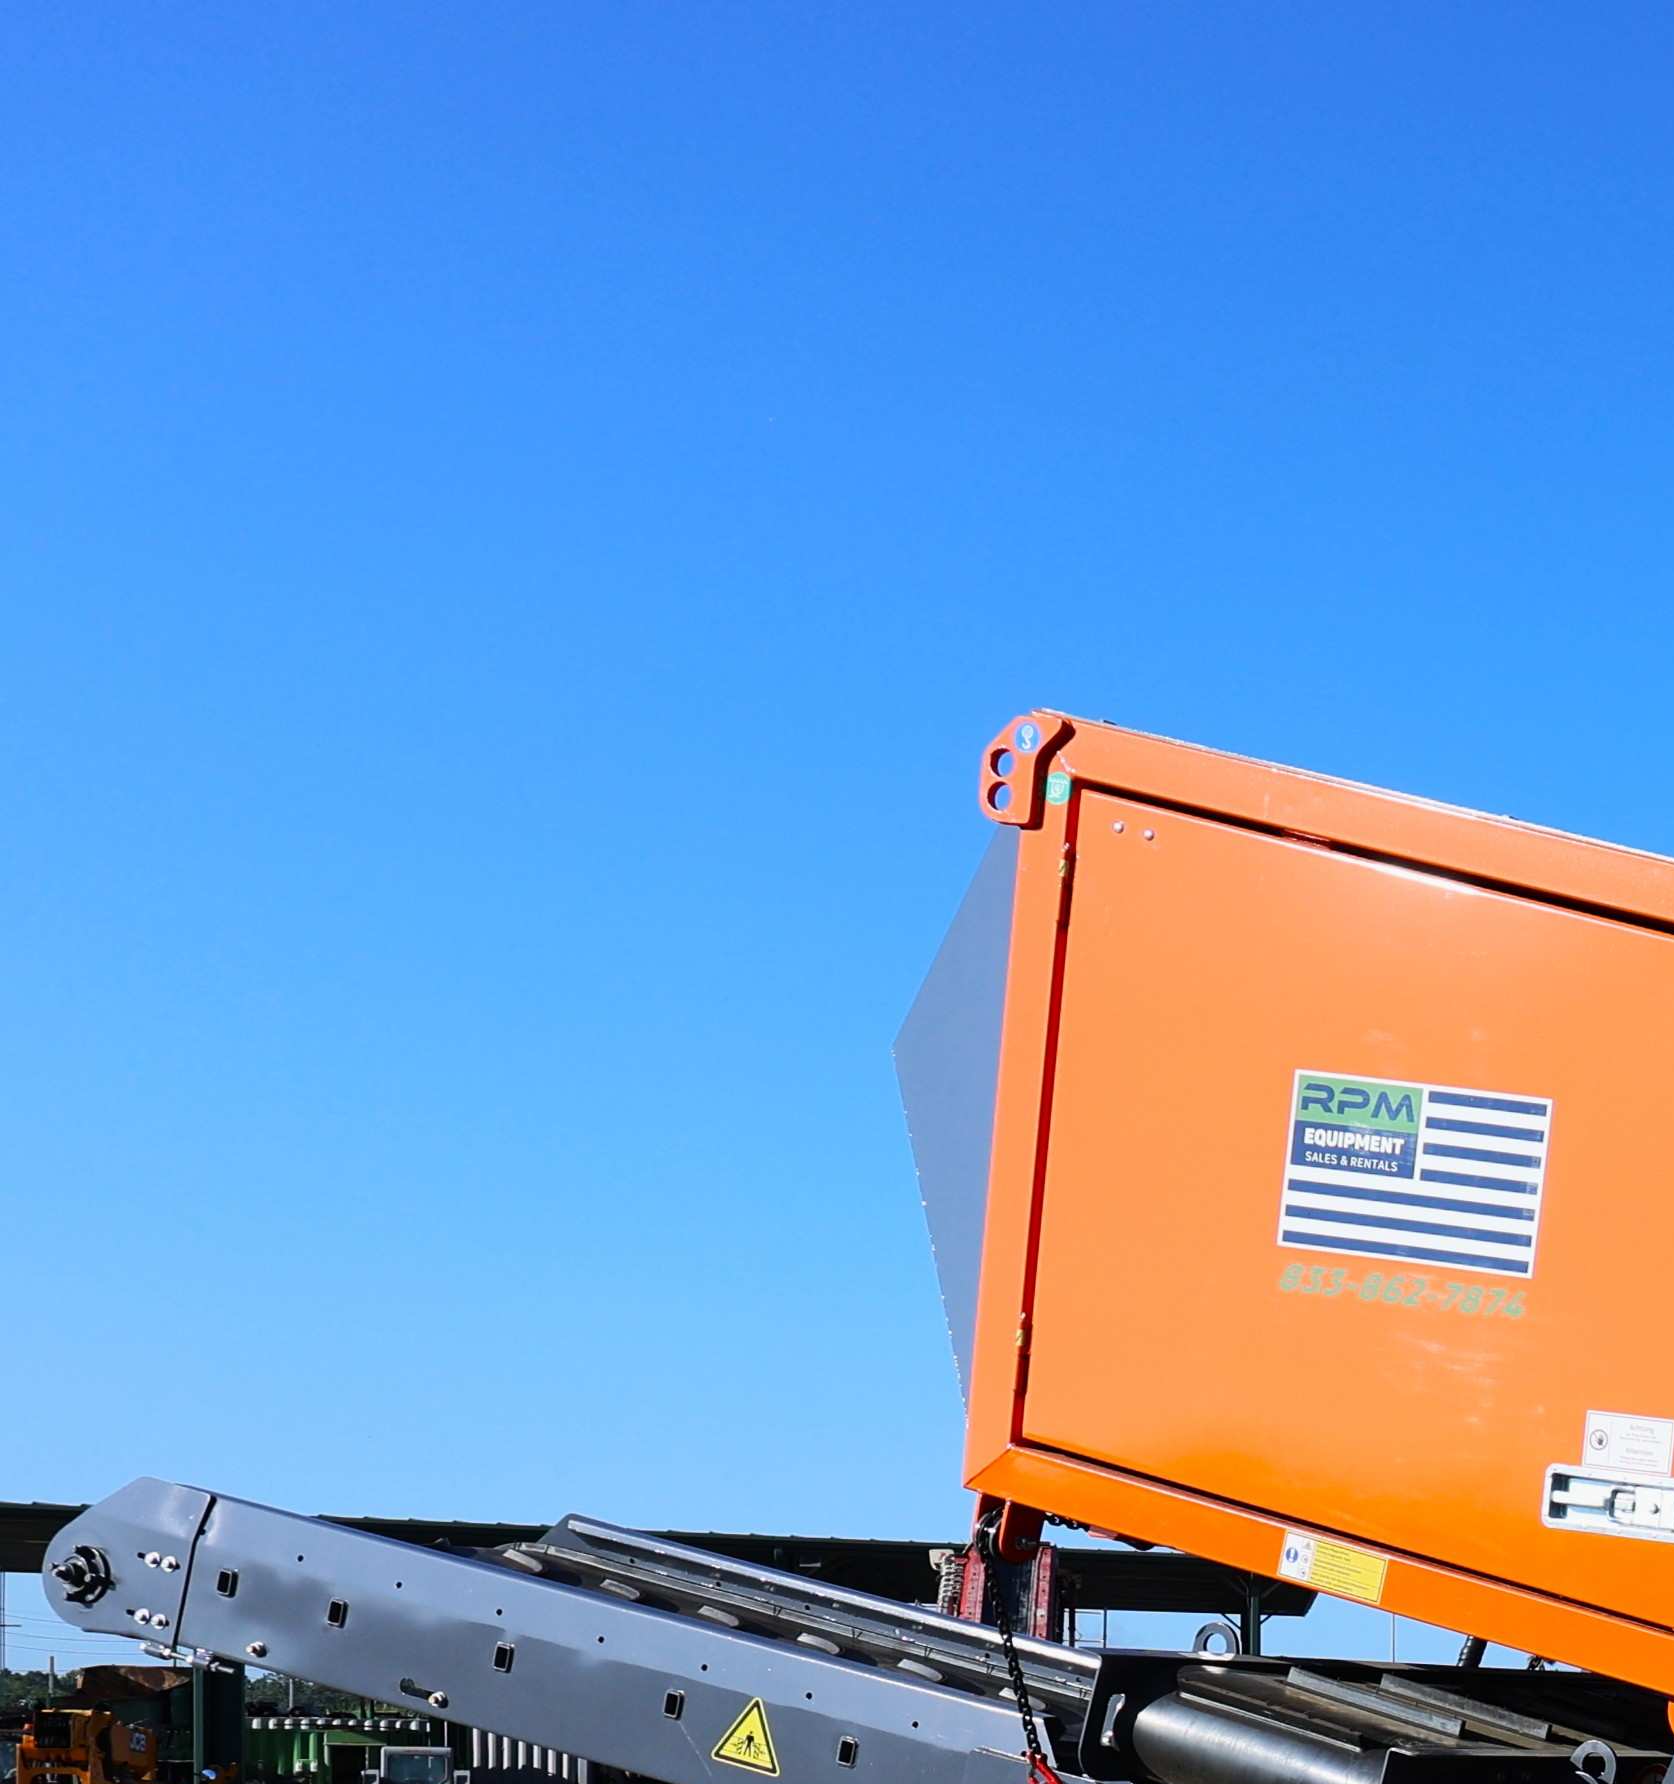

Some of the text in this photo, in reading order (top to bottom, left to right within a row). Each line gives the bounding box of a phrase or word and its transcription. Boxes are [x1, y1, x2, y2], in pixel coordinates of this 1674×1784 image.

[1300, 1082, 1415, 1123] RPM
[1303, 1127, 1405, 1155] EQUIPMENT
[1304, 1151, 1398, 1172] SALES & RENTALS
[1279, 1263, 1527, 1318] 833-862-7874
